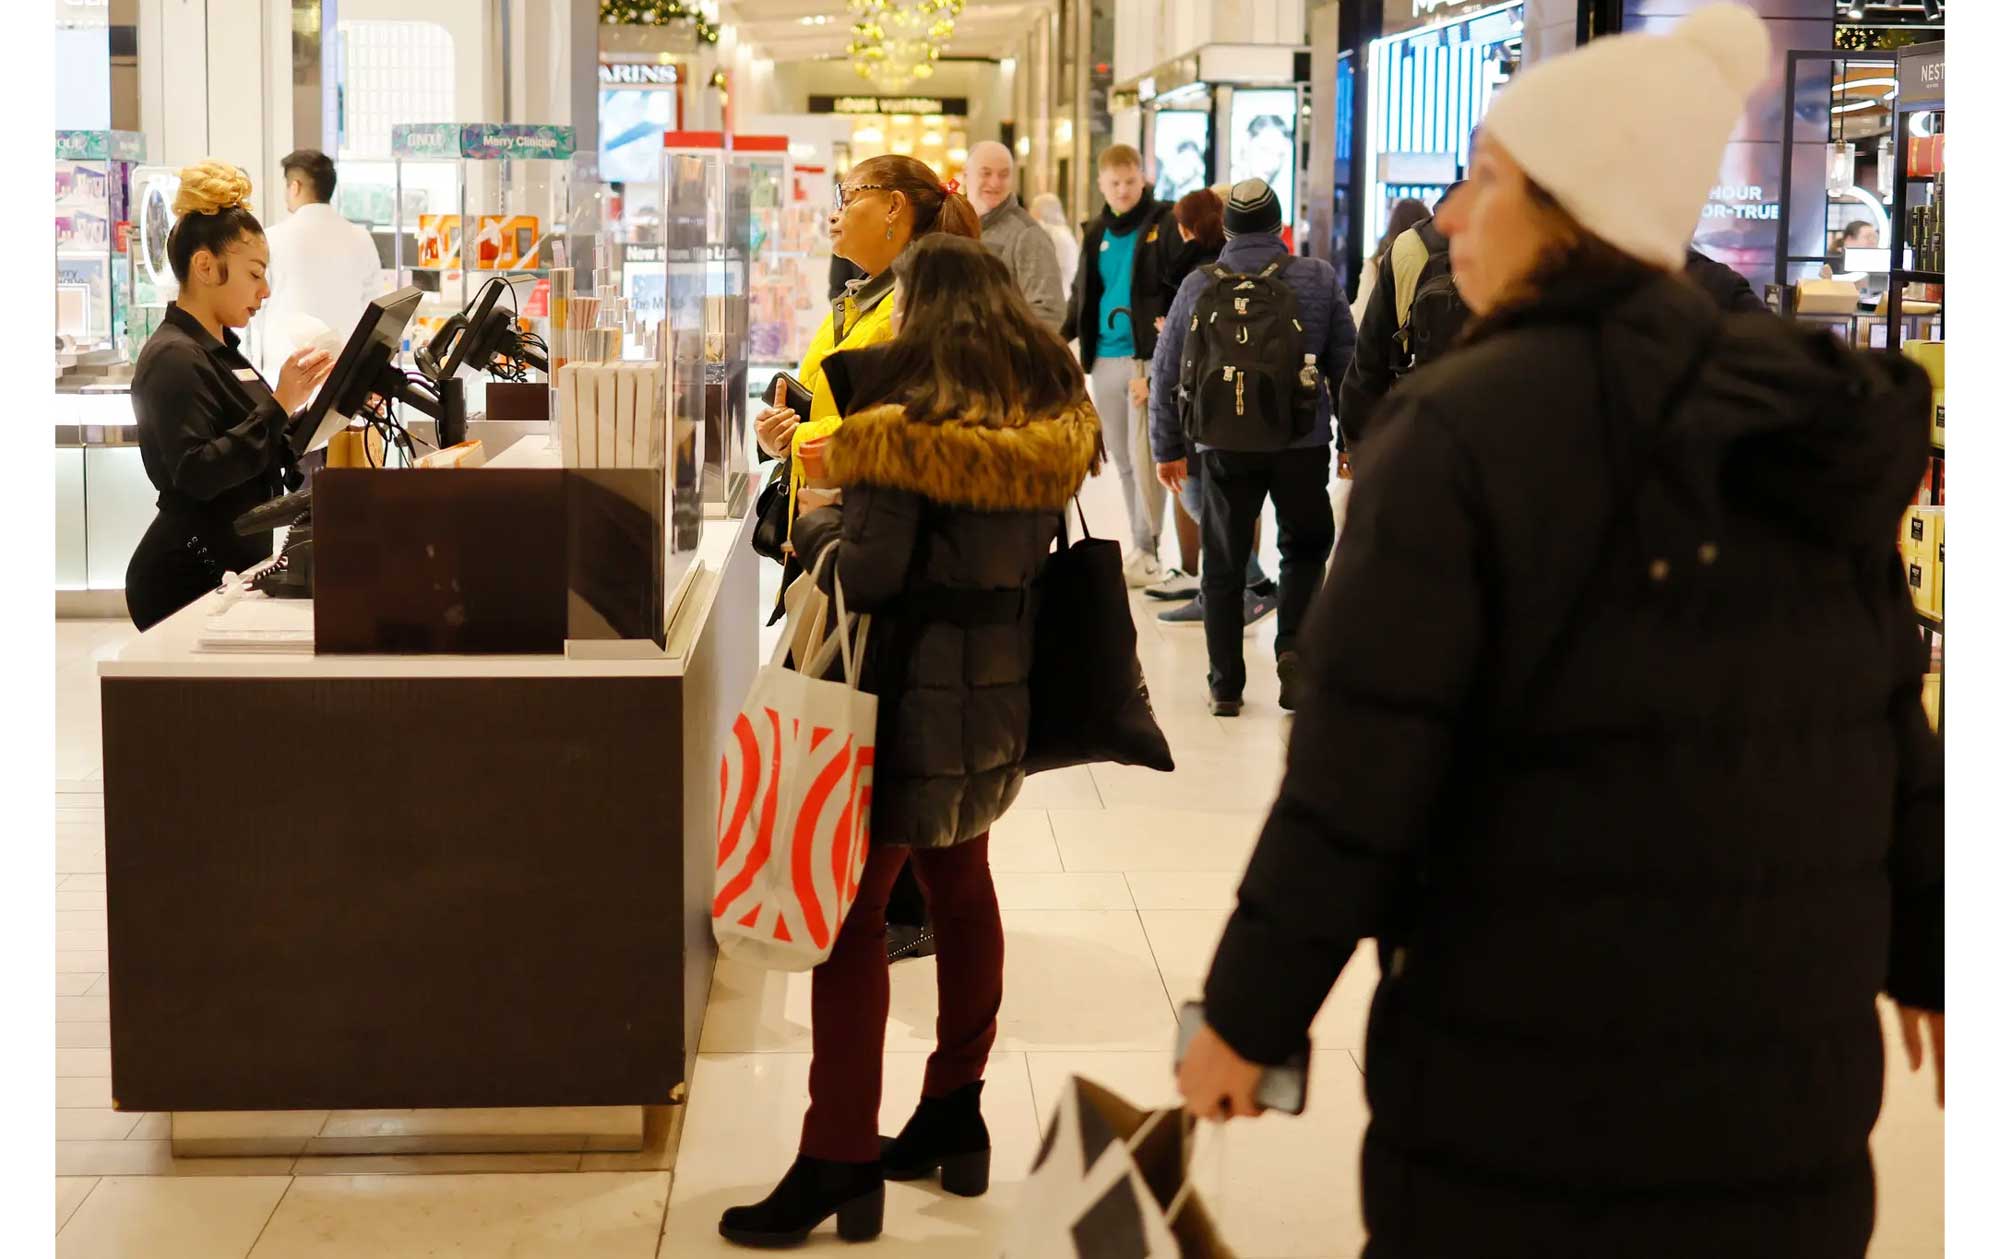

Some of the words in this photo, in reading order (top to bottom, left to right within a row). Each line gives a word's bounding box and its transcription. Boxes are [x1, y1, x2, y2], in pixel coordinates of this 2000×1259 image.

[1921, 63, 1945, 82] NEST
[483, 136, 513, 149] Merry
[516, 136, 557, 149] Clinique
[626, 245, 656, 260] New
